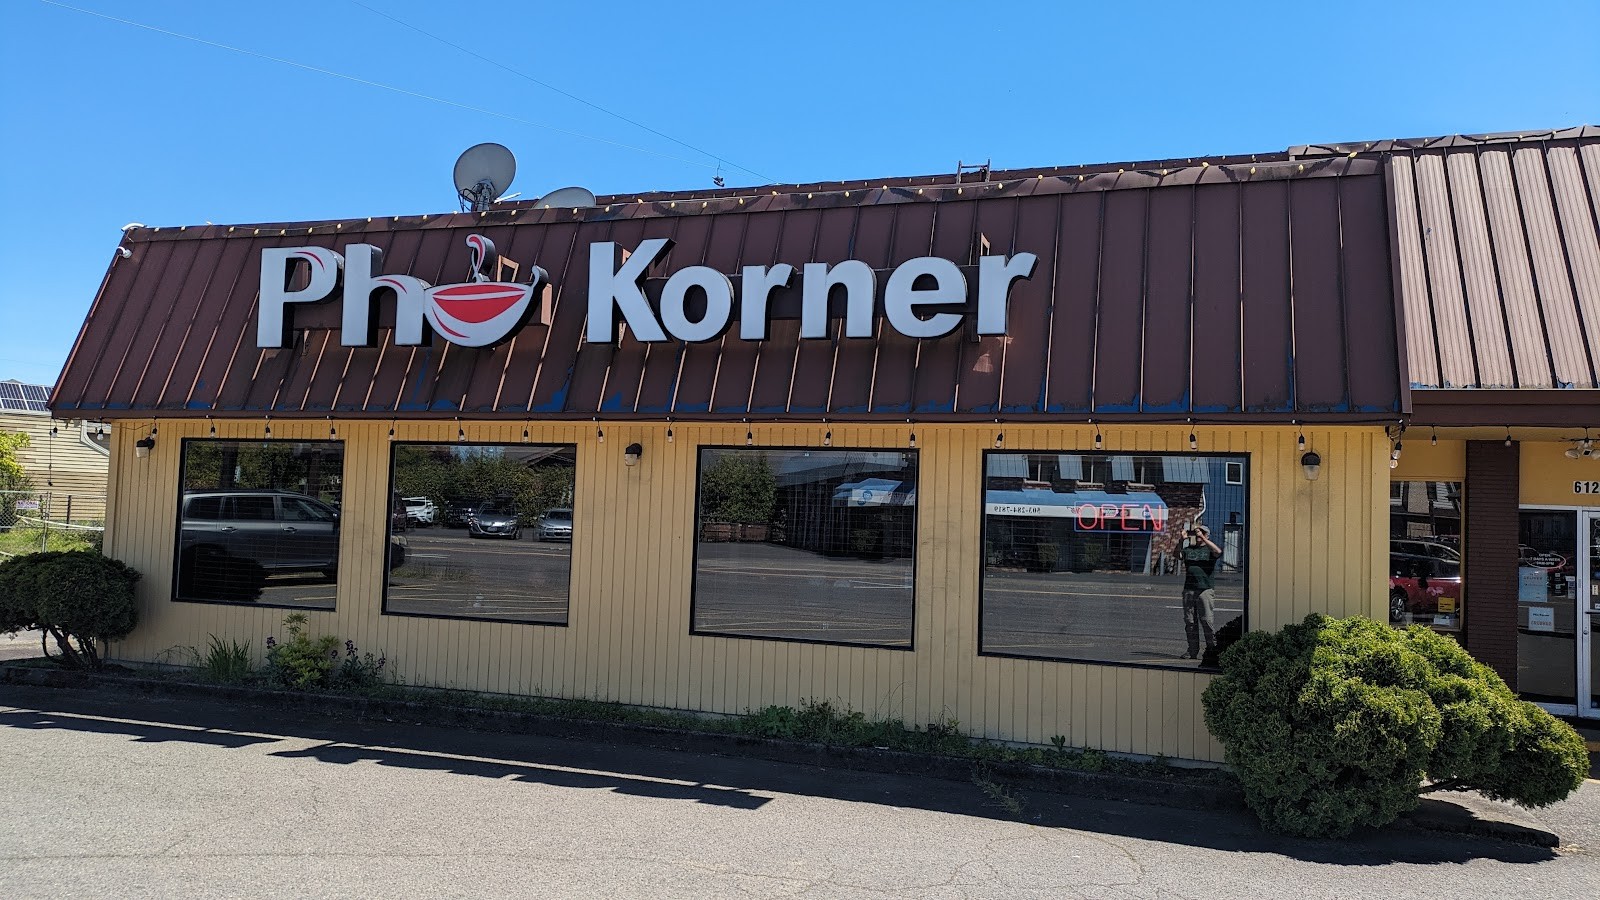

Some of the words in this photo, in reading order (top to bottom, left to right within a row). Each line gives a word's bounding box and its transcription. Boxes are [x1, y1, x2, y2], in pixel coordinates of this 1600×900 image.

[587, 238, 1040, 343] Korner
[1574, 481, 1600, 494] 612
[1078, 503, 1162, 531] OPEN
